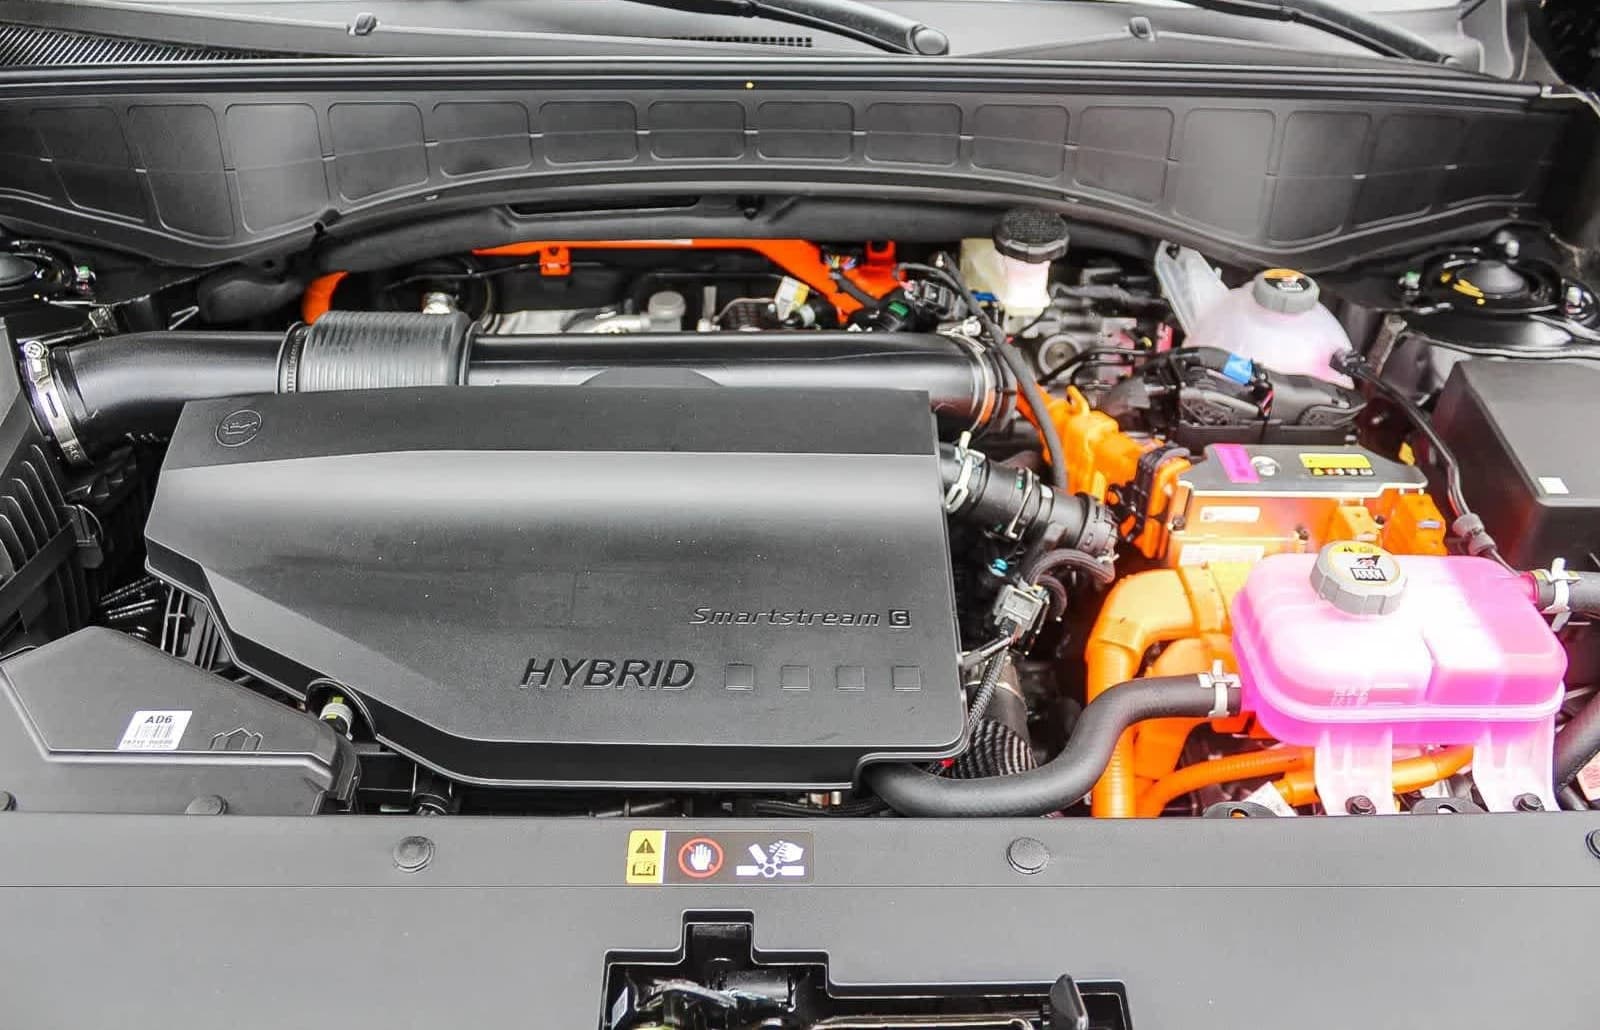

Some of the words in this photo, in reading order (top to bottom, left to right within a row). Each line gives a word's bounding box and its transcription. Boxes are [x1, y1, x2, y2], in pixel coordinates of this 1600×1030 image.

[689, 608, 880, 627] Smartstream
[890, 610, 910, 626] G
[519, 658, 695, 690] HYBRID
